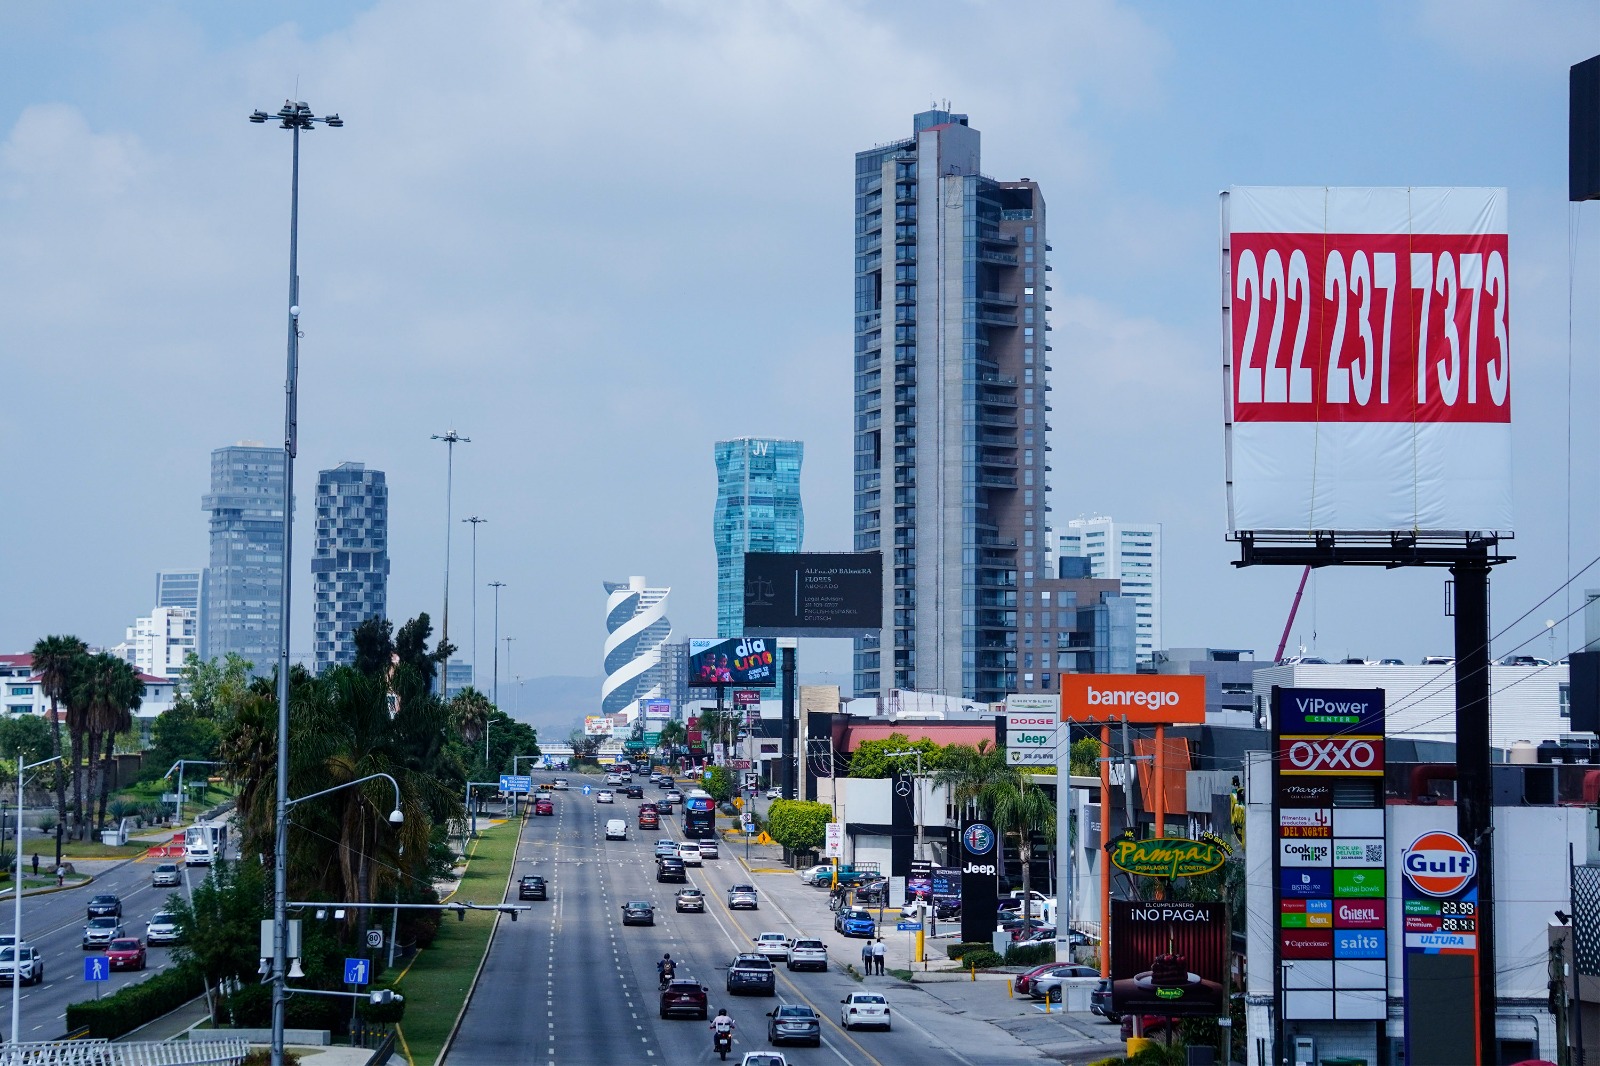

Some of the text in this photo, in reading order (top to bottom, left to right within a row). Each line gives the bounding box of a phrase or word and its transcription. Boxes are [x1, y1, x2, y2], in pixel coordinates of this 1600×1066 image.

[1237, 249, 1508, 406] 222 237 7373
[753, 442, 768, 456] JV
[734, 651, 773, 671] uno
[1087, 686, 1180, 711] banregio
[1295, 697, 1369, 714] ViPower
[1314, 715, 1351, 723] CENTER
[1016, 733, 1047, 746] Jeep
[1289, 740, 1375, 770] OXXO
[1284, 827, 1328, 837] DEL NORTE
[1284, 844, 1328, 857] Cooking
[1301, 853, 1321, 862] mix
[1118, 841, 1214, 879] Pampas
[1406, 853, 1471, 874] Gulf
[1131, 908, 1210, 922] ¡NO PAGA!
[1442, 901, 1474, 915] 23.99
[1442, 918, 1475, 931] 28.41
[369, 934, 379, 942] 80
[1420, 936, 1465, 945] ULTURA
